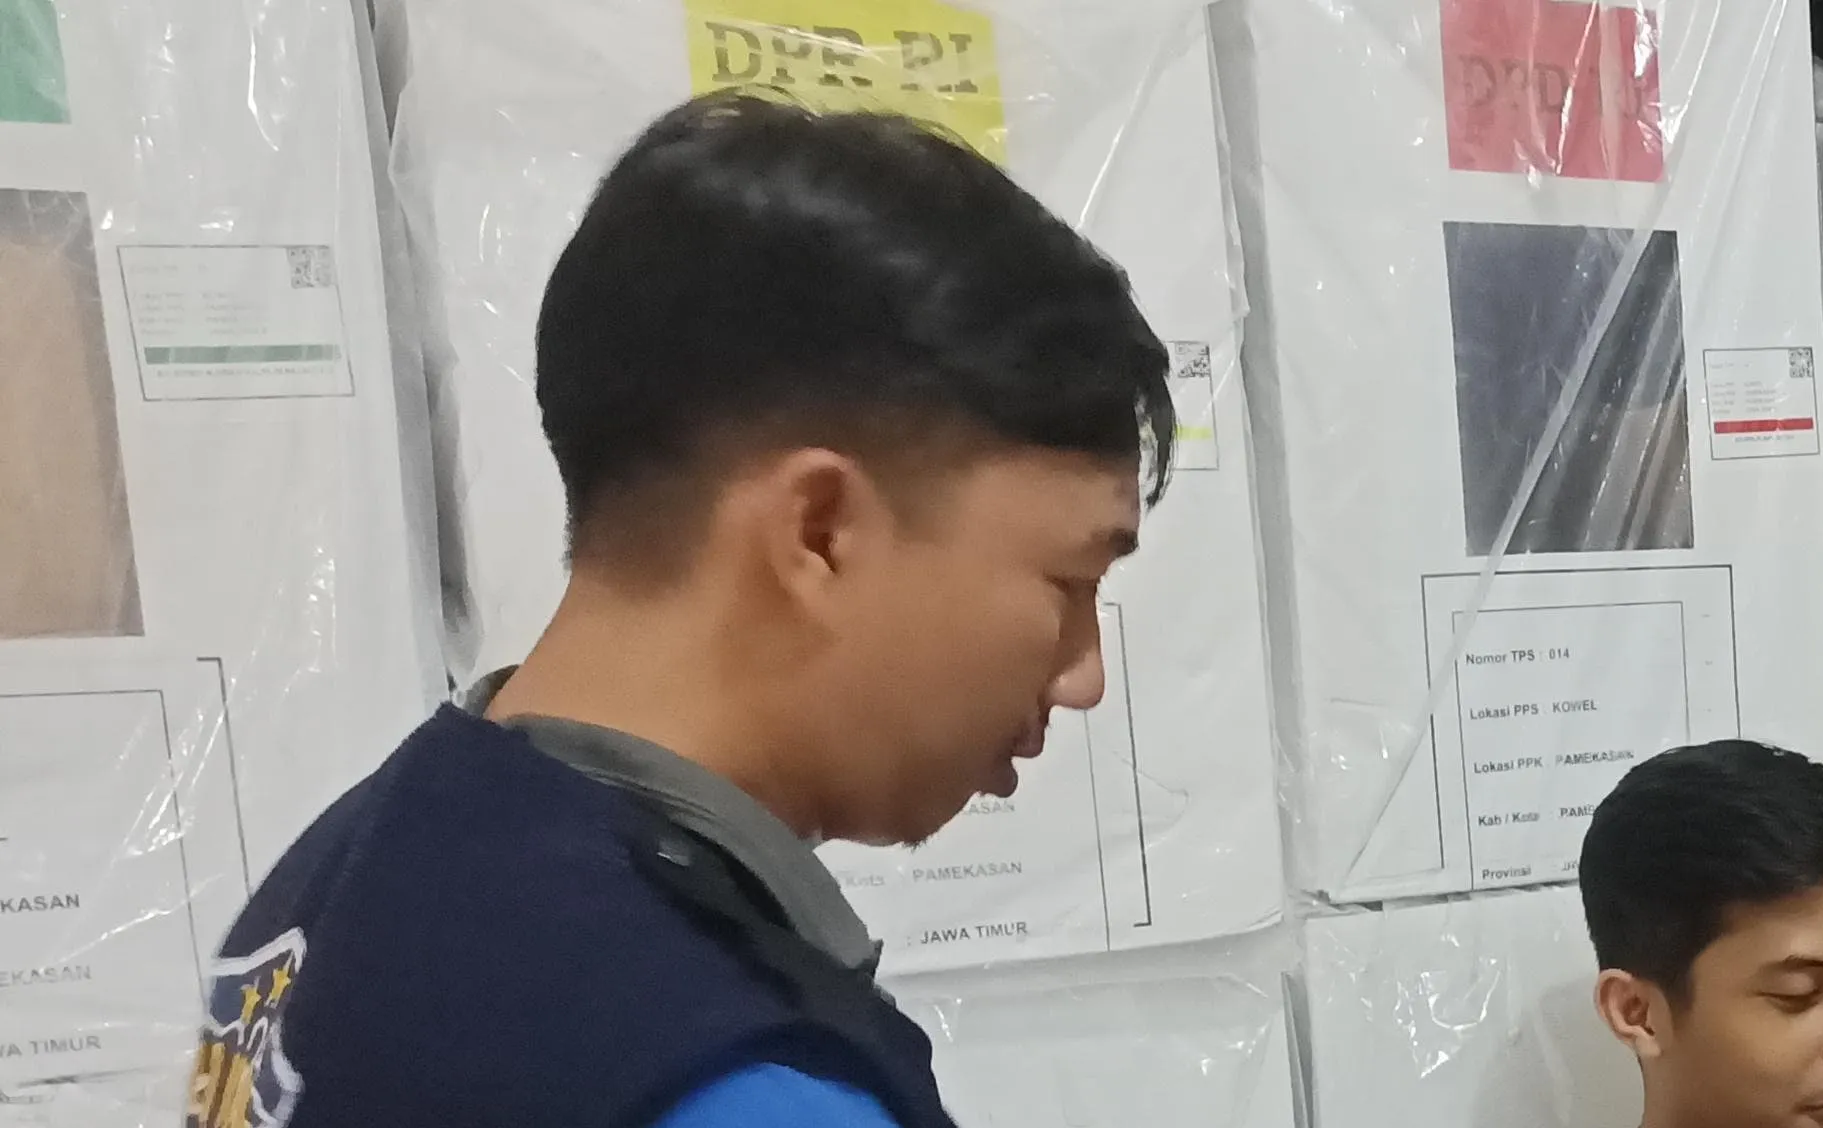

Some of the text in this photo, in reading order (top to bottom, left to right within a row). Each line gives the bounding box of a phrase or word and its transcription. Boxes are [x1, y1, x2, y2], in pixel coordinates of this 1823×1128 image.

[704, 21, 873, 88] DPR
[1466, 653, 1508, 665] Nomor
[1511, 649, 1536, 663] TPS
[1470, 705, 1511, 720] Lokasi
[1513, 703, 1539, 717] PPS
[1517, 756, 1544, 769] PPK
[965, 800, 1016, 816] ASAN
[912, 861, 1023, 882] PAMEKASAN
[921, 927, 971, 945] JAWA
[975, 921, 1028, 938] TIMUR
[29, 1034, 101, 1055] TIMUR
